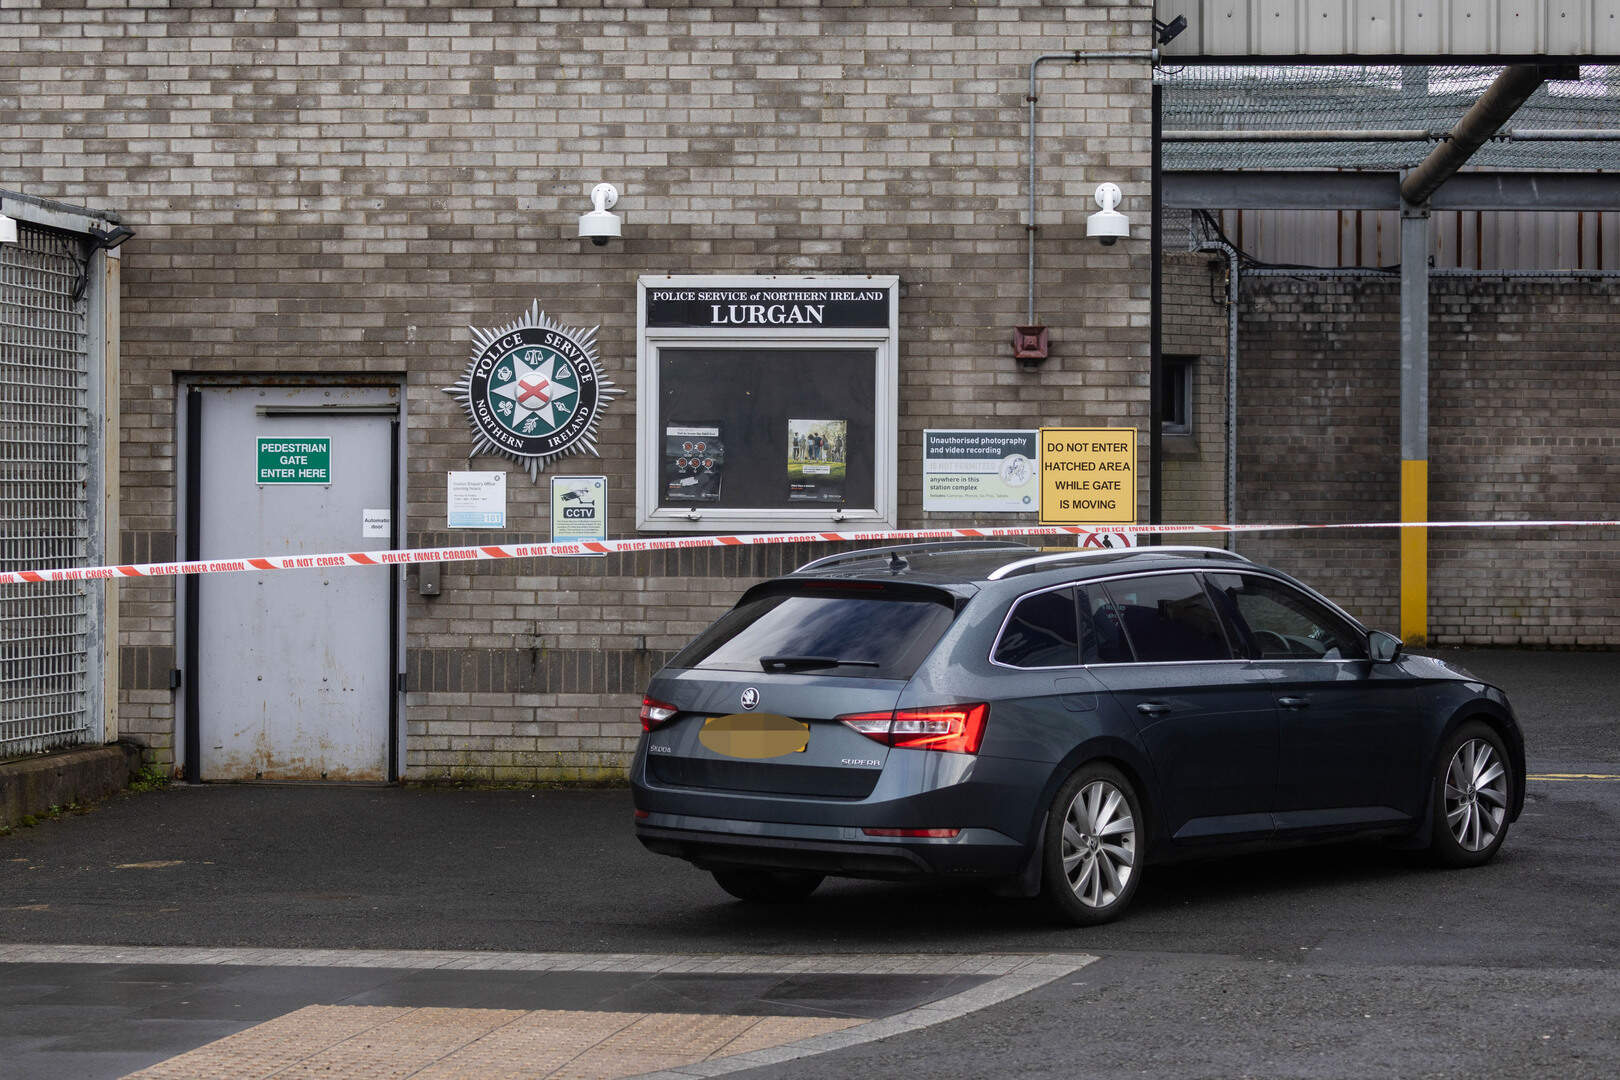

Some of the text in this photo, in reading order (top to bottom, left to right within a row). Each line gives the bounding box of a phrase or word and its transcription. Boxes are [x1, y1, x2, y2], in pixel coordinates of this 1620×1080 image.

[653, 291, 883, 301] POLICE SERVICE of NORTHERN IRELAND
[711, 304, 825, 324] LURGAN
[476, 332, 593, 384] POLICE SERVICE
[476, 399, 589, 449] NORTHERN IRELAND
[930, 436, 1027, 446] Unauthorised photography
[261, 443, 327, 453] PEDESTRIAN
[930, 446, 1002, 455] and video recording
[1047, 442, 1128, 452] DO NOT ENTER
[279, 455, 308, 465] GATE
[1045, 461, 1131, 471] HATCHED AREA
[261, 468, 327, 478] ENTER HERE
[1055, 480, 1121, 490] WHILE GATE
[1059, 499, 1116, 509] IS MOVING
[566, 508, 594, 518] CCTV
[854, 531, 953, 541] POLICE INNER CORDON
[1007, 528, 1024, 536] NOT
[1027, 527, 1057, 536] CROSS
[767, 536, 784, 544] NOT
[788, 535, 817, 544] CROSS
[516, 544, 580, 556] DO NOT CROSS
[616, 540, 714, 551] POLICE INNER CORDON
[381, 549, 478, 563] POLICE INNER CORDON
[282, 556, 345, 568] DO NOT CROSS
[149, 561, 245, 575] POLICE INNER CORDON
[51, 568, 114, 581] DO NOT CROSS
[841, 758, 881, 767] SUPERB
